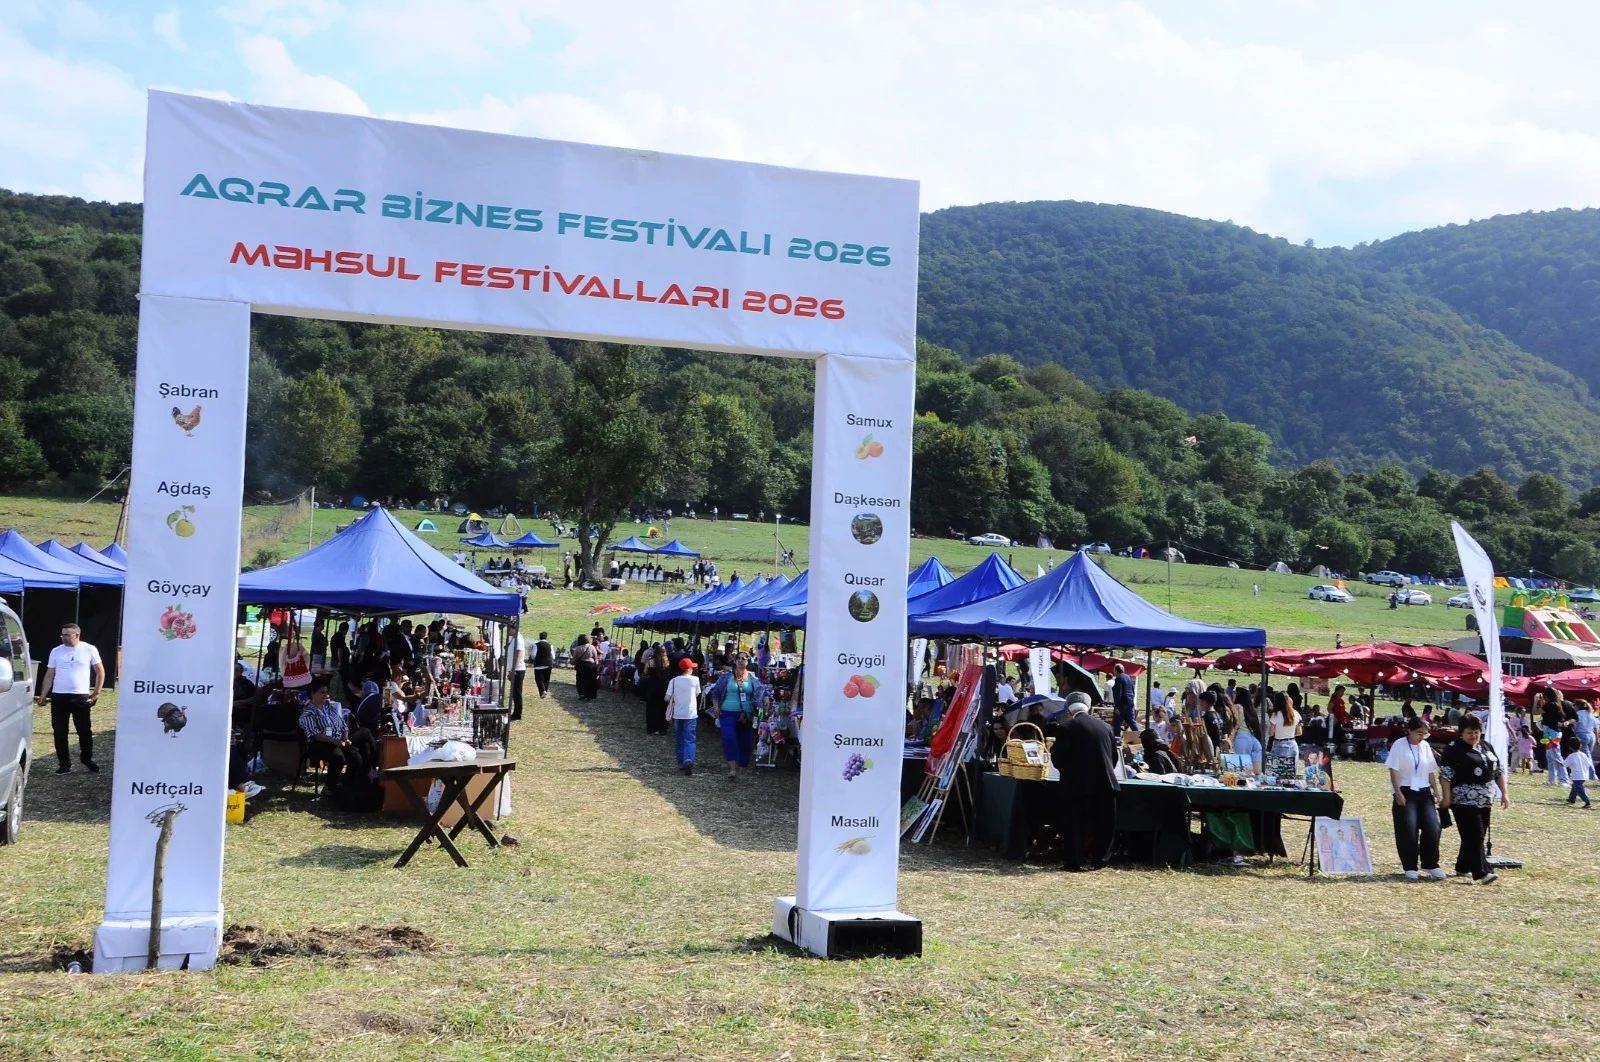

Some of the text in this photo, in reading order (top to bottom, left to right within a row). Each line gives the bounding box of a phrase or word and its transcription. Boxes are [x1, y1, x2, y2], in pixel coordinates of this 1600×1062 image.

[179, 173, 891, 267] AQRAR BİZNES FESTİVALI 2026
[434, 261, 730, 309] FESTİVALLARI
[742, 290, 845, 320] 2026
[158, 382, 219, 399] Şabran
[846, 413, 893, 429] Samux
[156, 480, 211, 500] Ağdaş
[834, 492, 901, 509] Daşkəsən
[844, 572, 886, 587] Qusar
[147, 579, 212, 598] Göyçay
[837, 652, 886, 669] Göygöl
[133, 680, 214, 695] Biləsuvar
[833, 733, 884, 749] Şamaxı
[131, 781, 203, 799] Neftçala
[831, 815, 879, 828] Masallı
